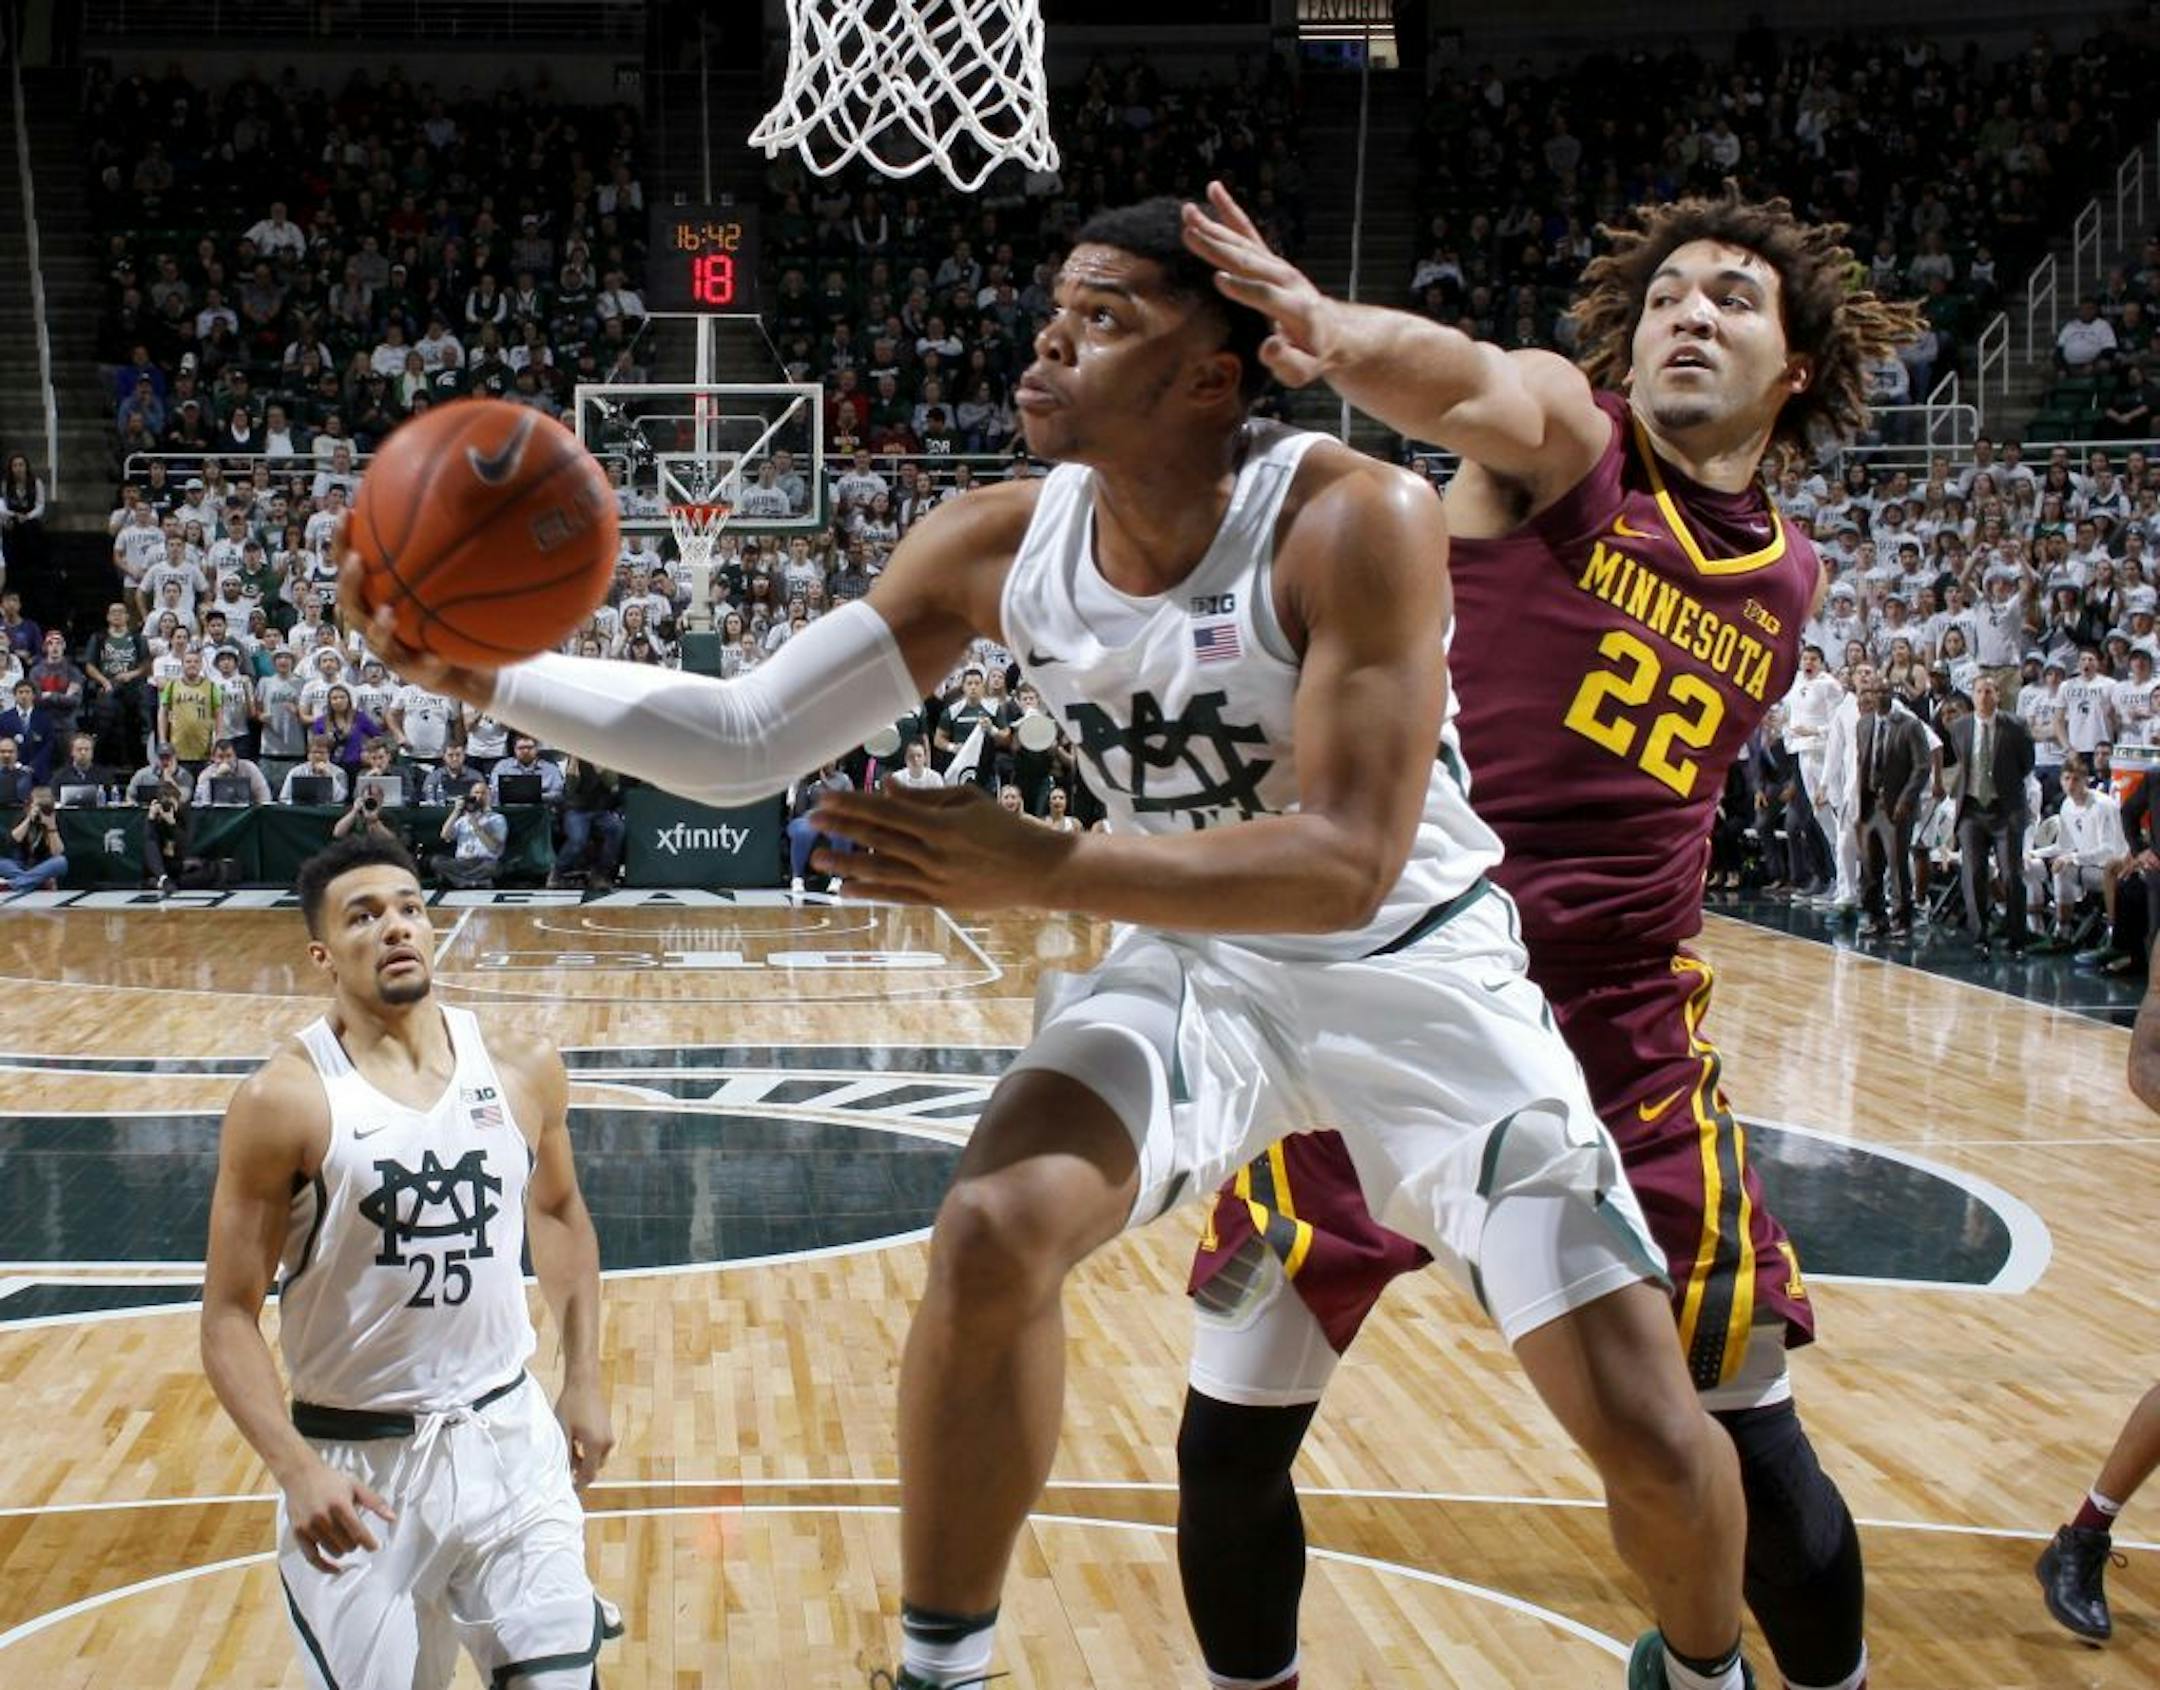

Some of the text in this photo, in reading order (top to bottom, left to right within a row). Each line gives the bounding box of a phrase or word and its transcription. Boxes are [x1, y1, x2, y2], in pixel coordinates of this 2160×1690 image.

[678, 223, 742, 251] 16:42
[693, 254, 734, 304] 18
[1579, 541, 1774, 701] MINNESOTA
[1564, 630, 1725, 798] 22
[656, 821, 751, 856] xfinity
[404, 1250, 473, 1309] 25
